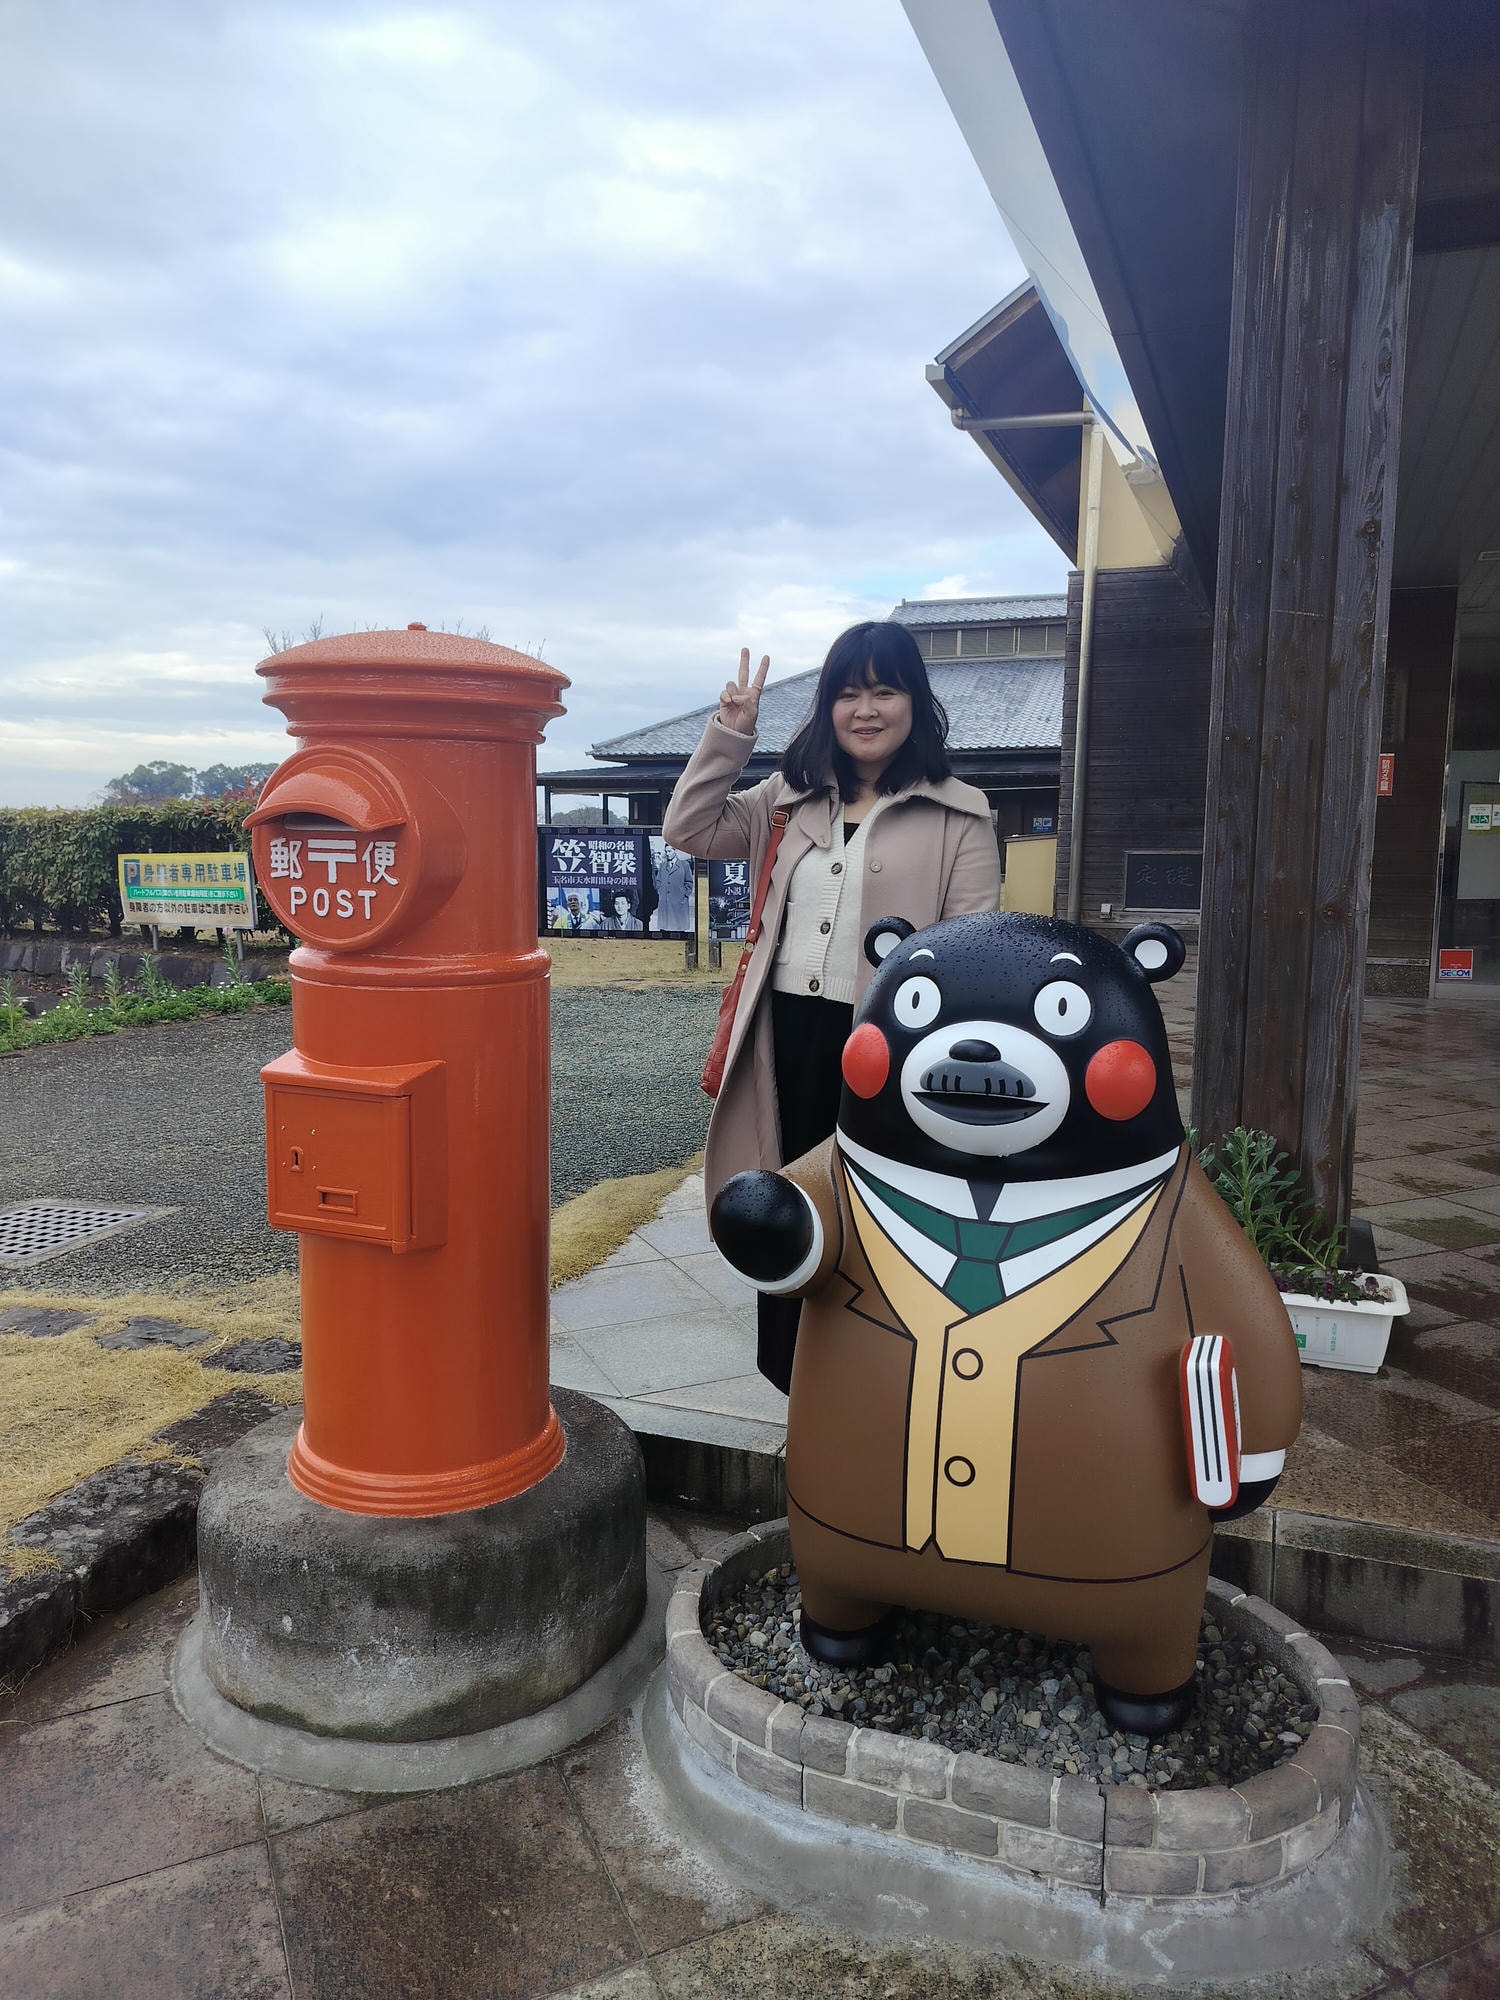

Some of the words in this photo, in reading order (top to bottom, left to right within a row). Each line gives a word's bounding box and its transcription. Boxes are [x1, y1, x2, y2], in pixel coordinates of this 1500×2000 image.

[551, 839, 636, 874] 笠智衆
[588, 840, 635, 852] 昭和の名優
[143, 862, 246, 884] 身障者専用駐車場
[551, 875, 638, 886] 玉名市天水町出身の俳優
[723, 860, 748, 886] 夏
[290, 886, 377, 920] POST
[1440, 969, 1471, 977] SECOM
